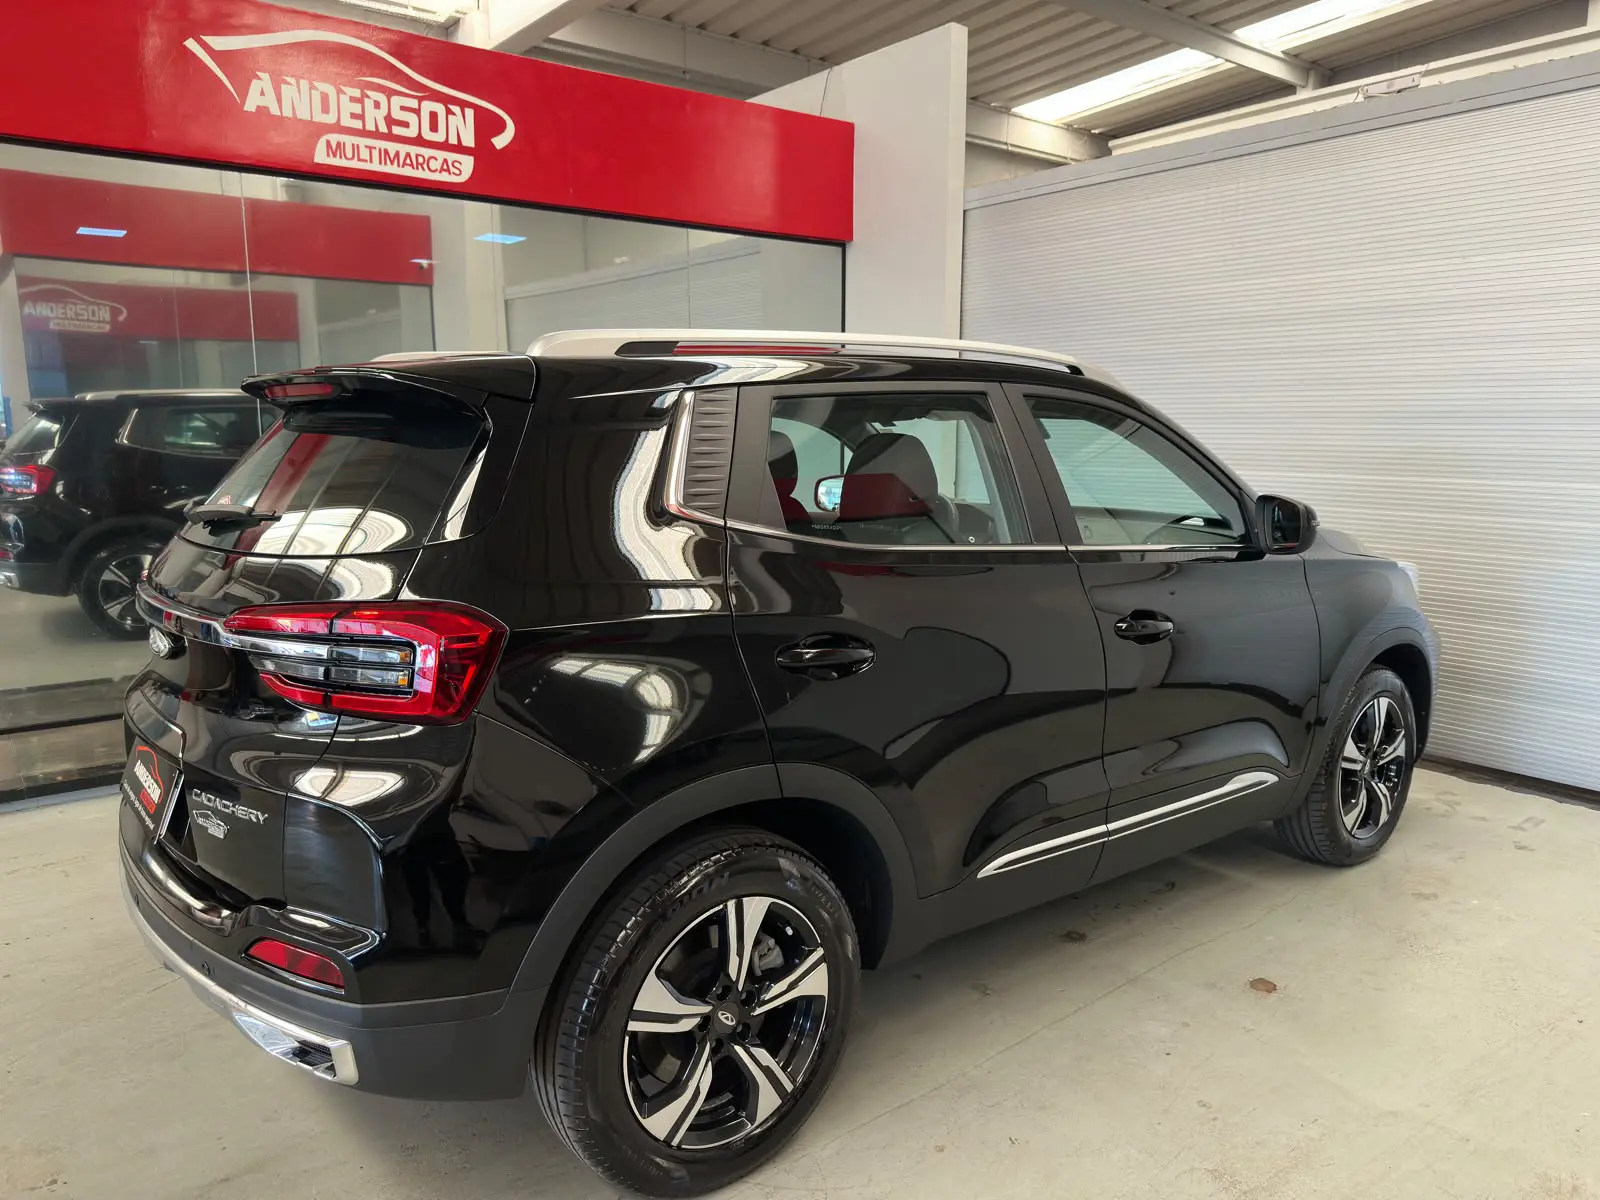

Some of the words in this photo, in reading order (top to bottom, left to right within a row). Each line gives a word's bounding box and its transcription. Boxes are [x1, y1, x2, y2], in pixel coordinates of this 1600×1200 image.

[244, 71, 475, 148] ANDERSON
[325, 139, 463, 176] MULTIMARCAS
[23, 301, 111, 322] ANDERSON
